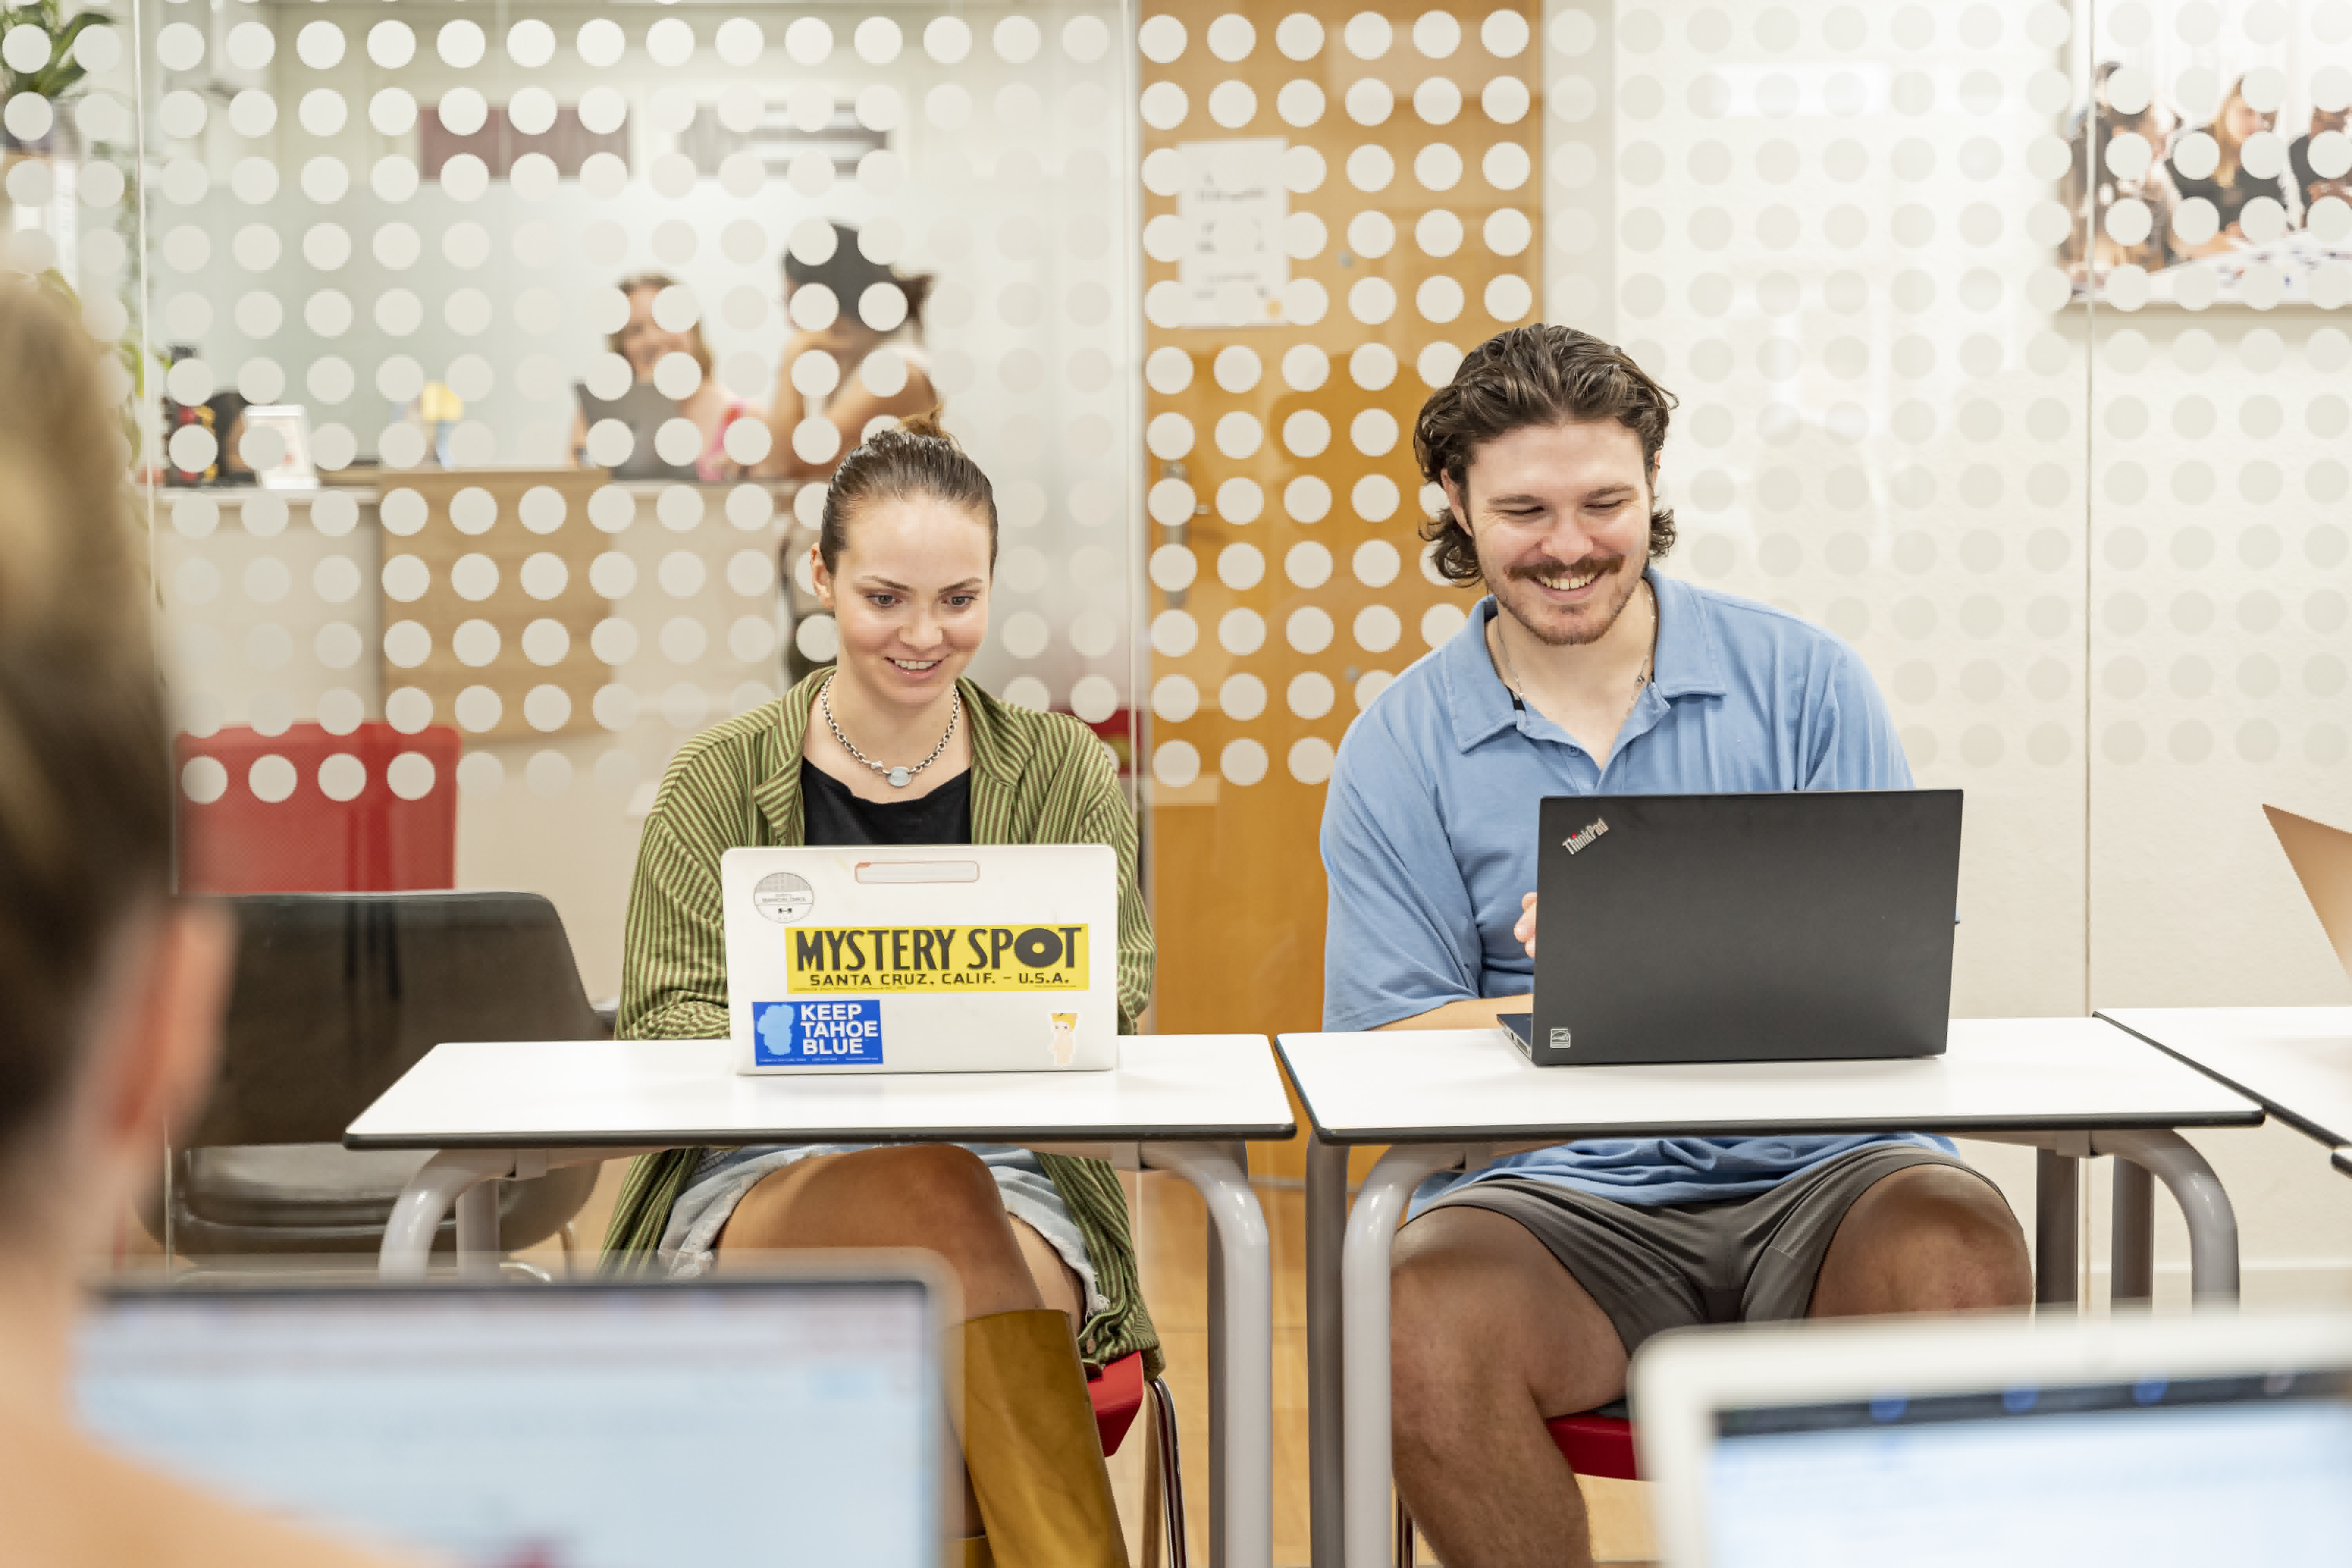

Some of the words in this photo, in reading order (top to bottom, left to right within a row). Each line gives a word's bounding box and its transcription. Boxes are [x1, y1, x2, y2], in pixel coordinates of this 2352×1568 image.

[1562, 817, 1609, 855] ThinkPad
[796, 929, 956, 972] MYSTERY
[967, 927, 1082, 970] SPOT
[810, 974, 872, 985] SANTA
[942, 972, 996, 985] CALIF.
[1019, 972, 1069, 984] U.S.A.
[801, 1004, 862, 1020] KEEP
[800, 1020, 878, 1038] TAHOE
[802, 1038, 864, 1055] BLUE
